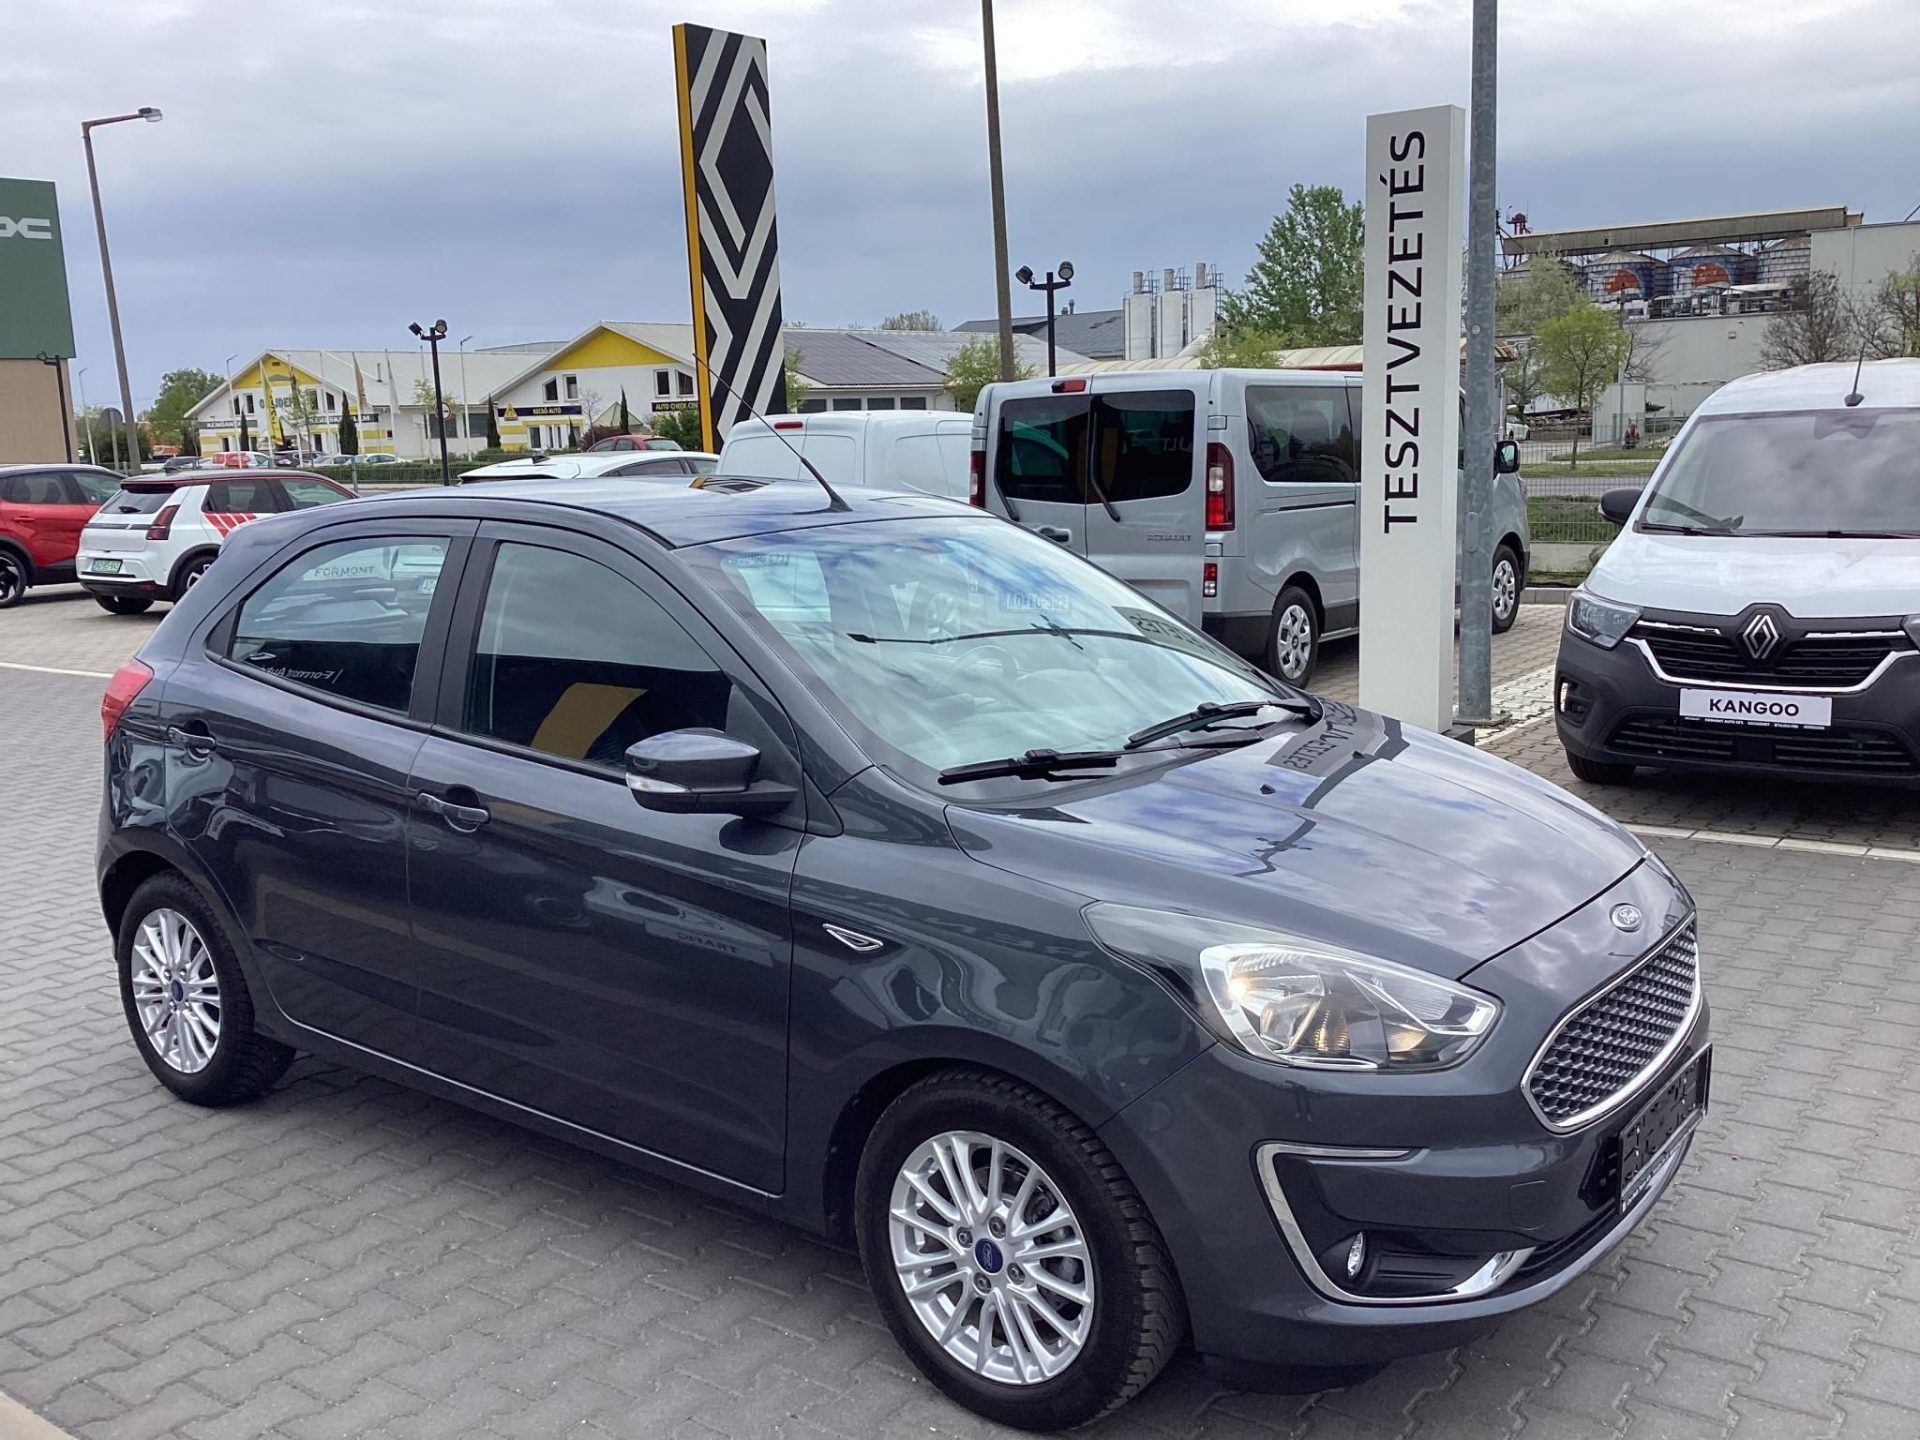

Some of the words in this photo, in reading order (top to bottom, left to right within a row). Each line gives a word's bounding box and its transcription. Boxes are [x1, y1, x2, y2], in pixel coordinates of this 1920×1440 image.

[1380, 130, 1426, 534] TESZTVEZETÉS
[314, 565, 376, 577] FORMONT
[1709, 698, 1799, 716] KANGOO
